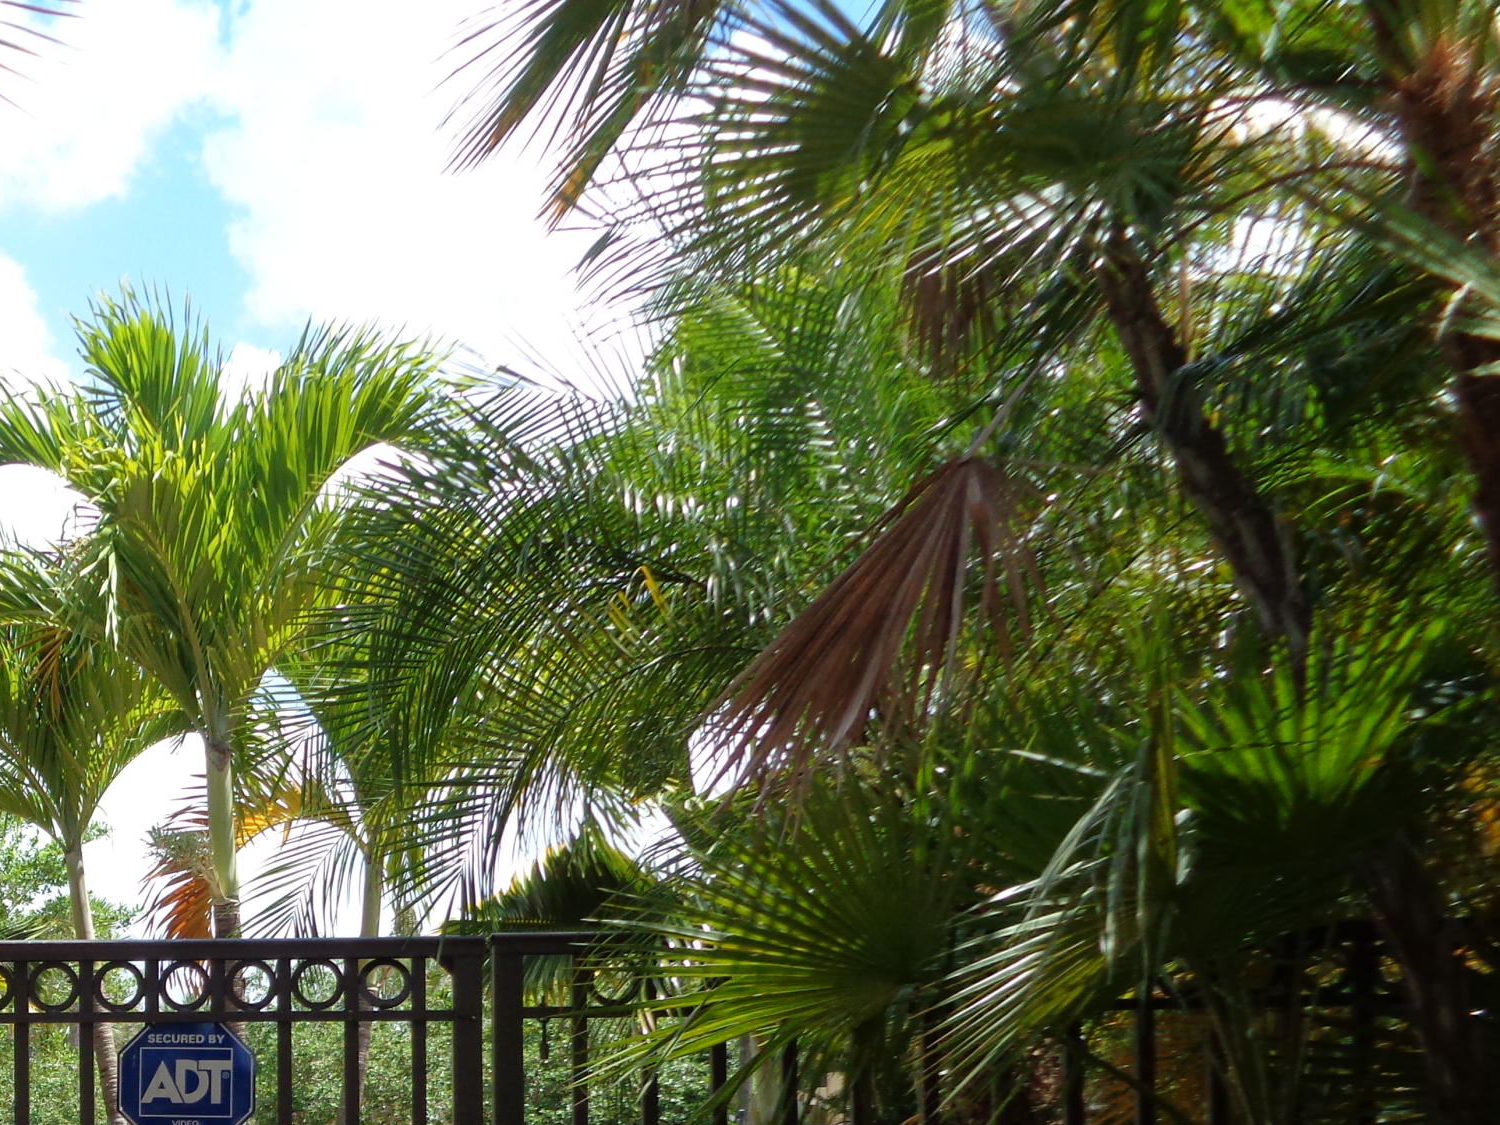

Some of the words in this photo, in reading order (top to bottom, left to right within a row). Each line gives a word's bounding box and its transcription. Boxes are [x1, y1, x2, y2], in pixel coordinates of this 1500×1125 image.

[147, 1033, 205, 1044] SECURED
[208, 1034, 225, 1044] BY
[141, 1059, 232, 1104] ADT
